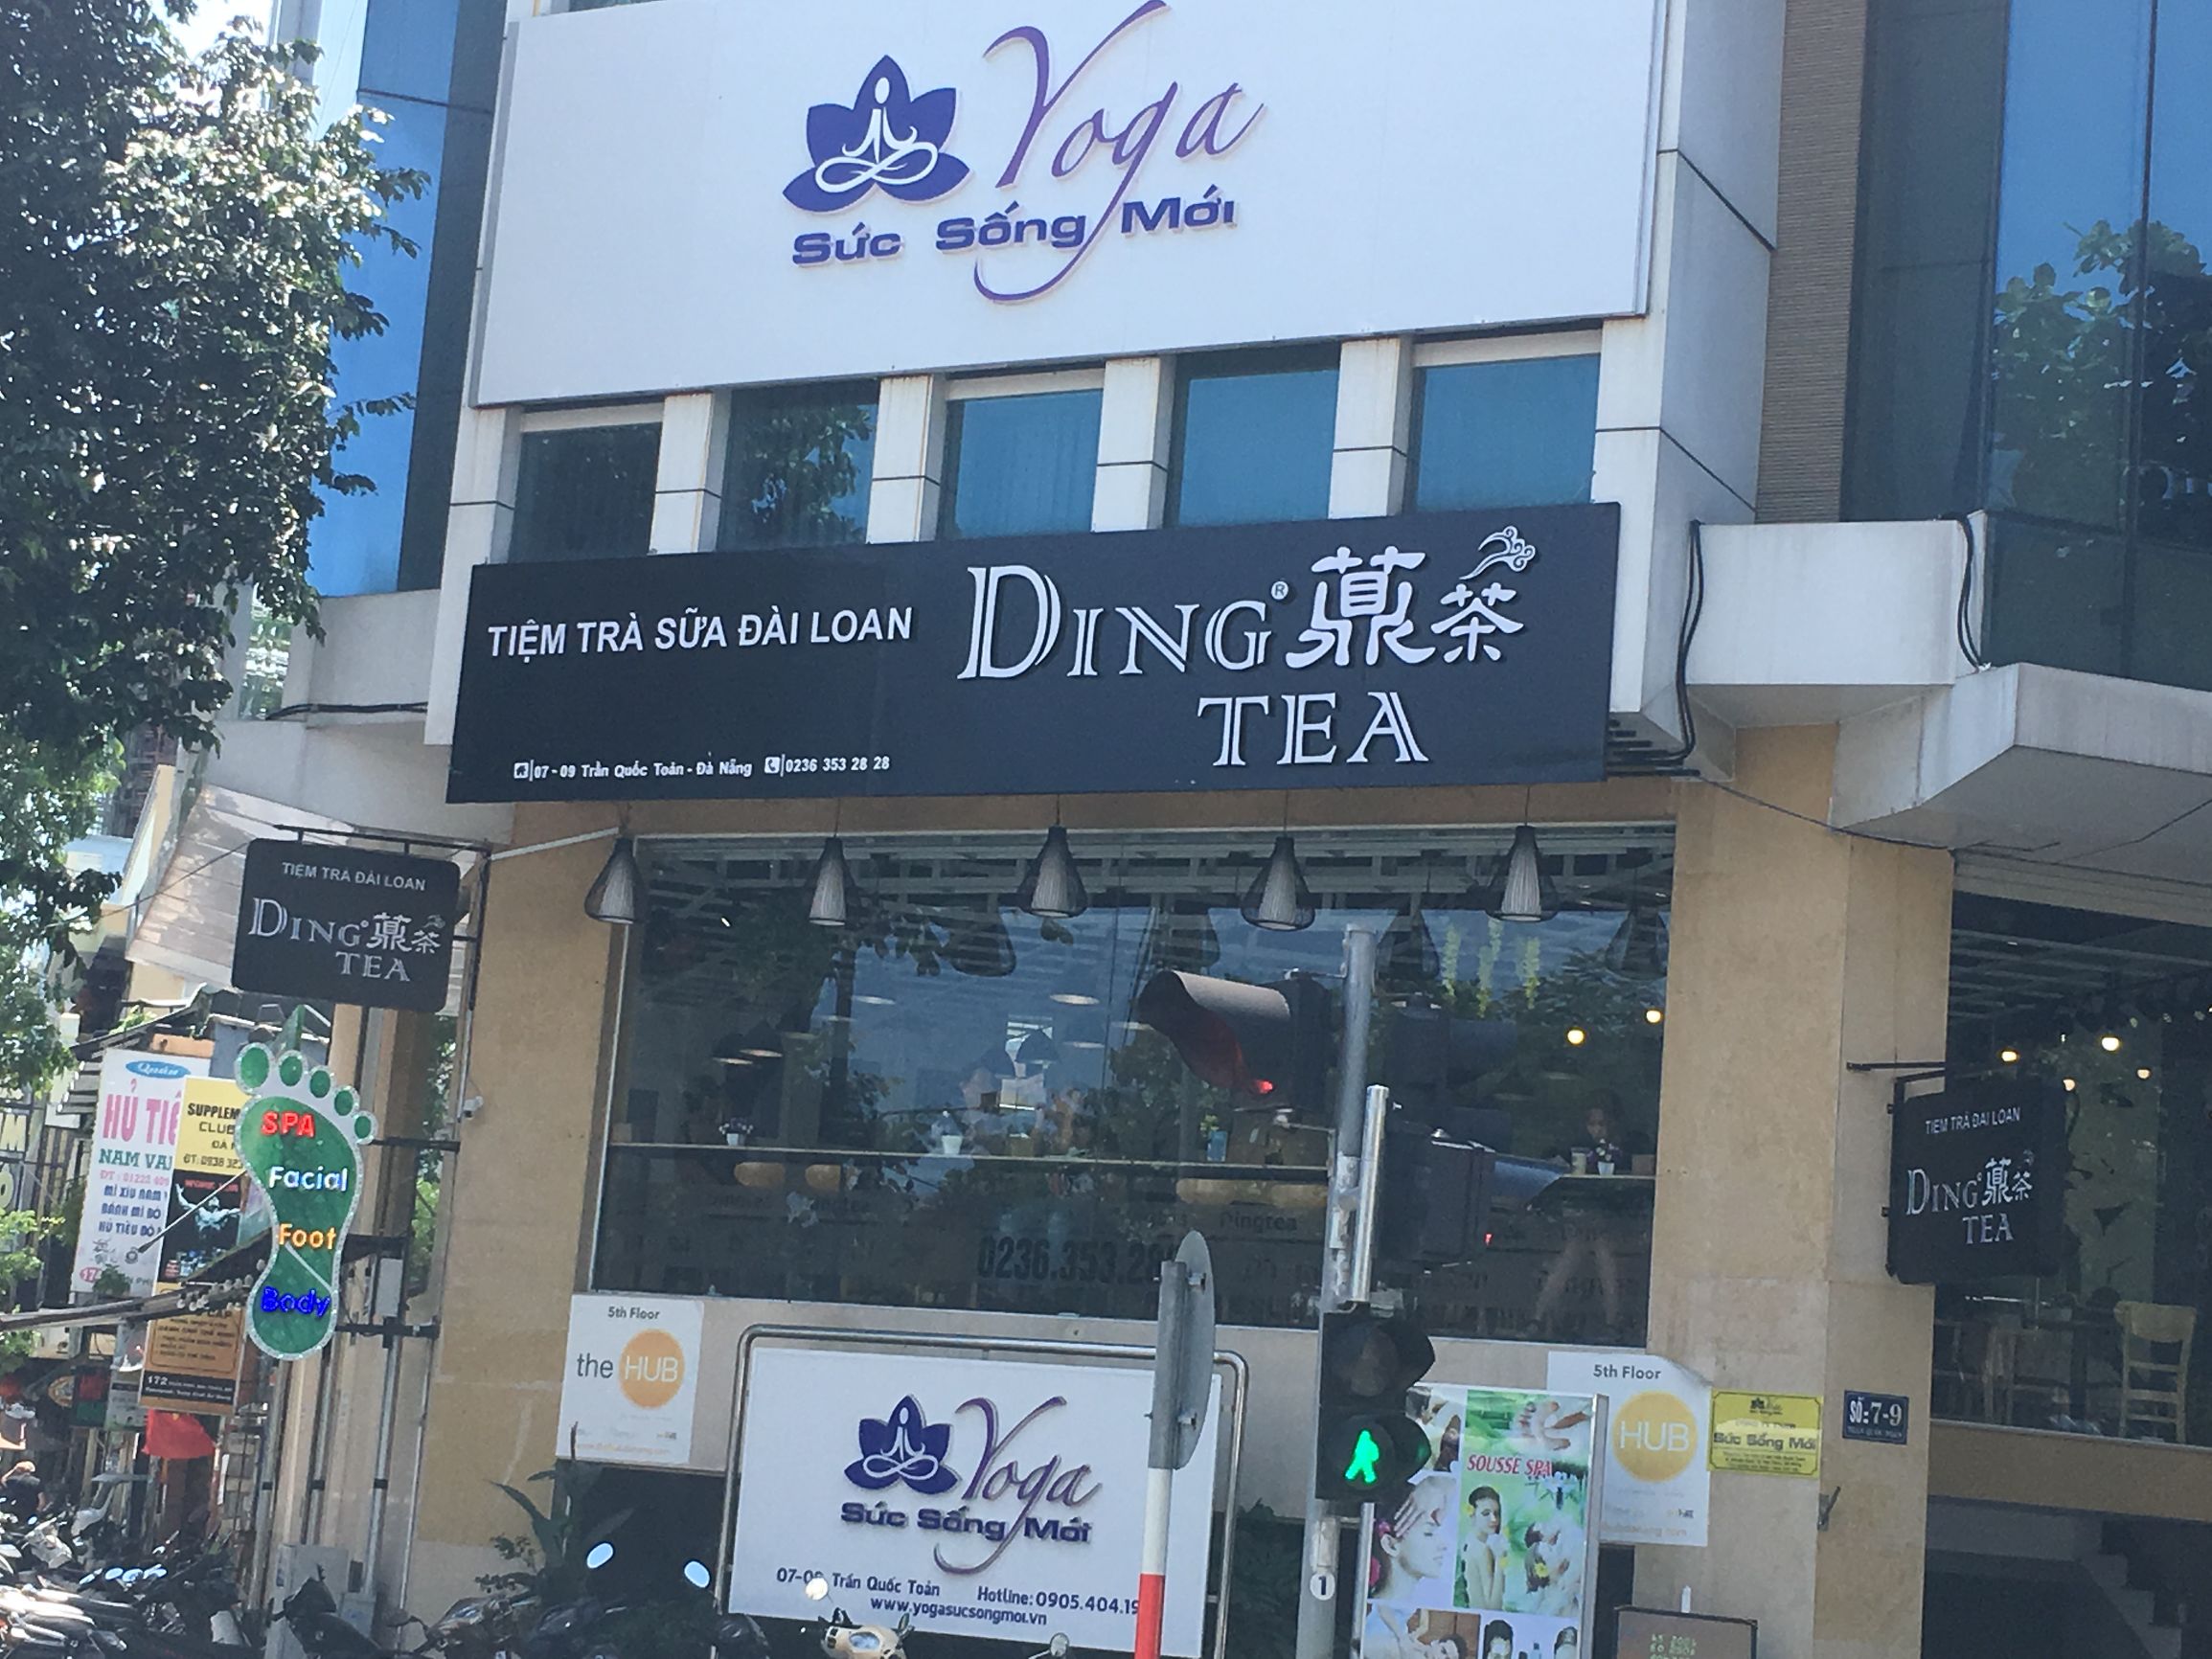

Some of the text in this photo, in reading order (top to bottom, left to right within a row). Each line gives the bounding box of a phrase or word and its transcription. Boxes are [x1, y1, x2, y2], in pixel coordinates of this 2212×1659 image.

[973, 0, 1265, 304] Yoga
[792, 185, 1237, 266] Sức Sống Mới
[487, 605, 913, 663] TIỆM TRÀ SỮA ĐÀI LOAN
[958, 564, 1271, 680] DING
[1197, 692, 1429, 766] TEA
[614, 760, 648, 777] Quốc
[718, 760, 753, 777] Nẵng
[786, 757, 890, 773] 0236 353 28 28
[383, 875, 426, 892] LOAN
[248, 898, 361, 947] DING
[335, 951, 410, 982] TEA
[261, 1111, 316, 1137] SPA
[1992, 1106, 2020, 1125] LOAN
[99, 1148, 141, 1167] NAM
[268, 1166, 348, 1192] Facial
[1905, 1169, 1978, 1216] DING
[278, 1223, 336, 1250] Foot
[1962, 1214, 2015, 1244] TEA
[260, 1286, 332, 1318] Body
[607, 1306, 661, 1320] 5th Floor
[577, 1352, 679, 1382] the HUB
[1593, 1363, 1662, 1380] 5th Floor
[1618, 1420, 1690, 1452] HUB
[1467, 1454, 1553, 1477] SOUSSE SPA
[933, 1396, 1103, 1576] Yoga
[841, 1501, 1092, 1542] Sức Sống Mới
[866, 1576, 901, 1594] Quốc
[1317, 1576, 1327, 1596] 1
